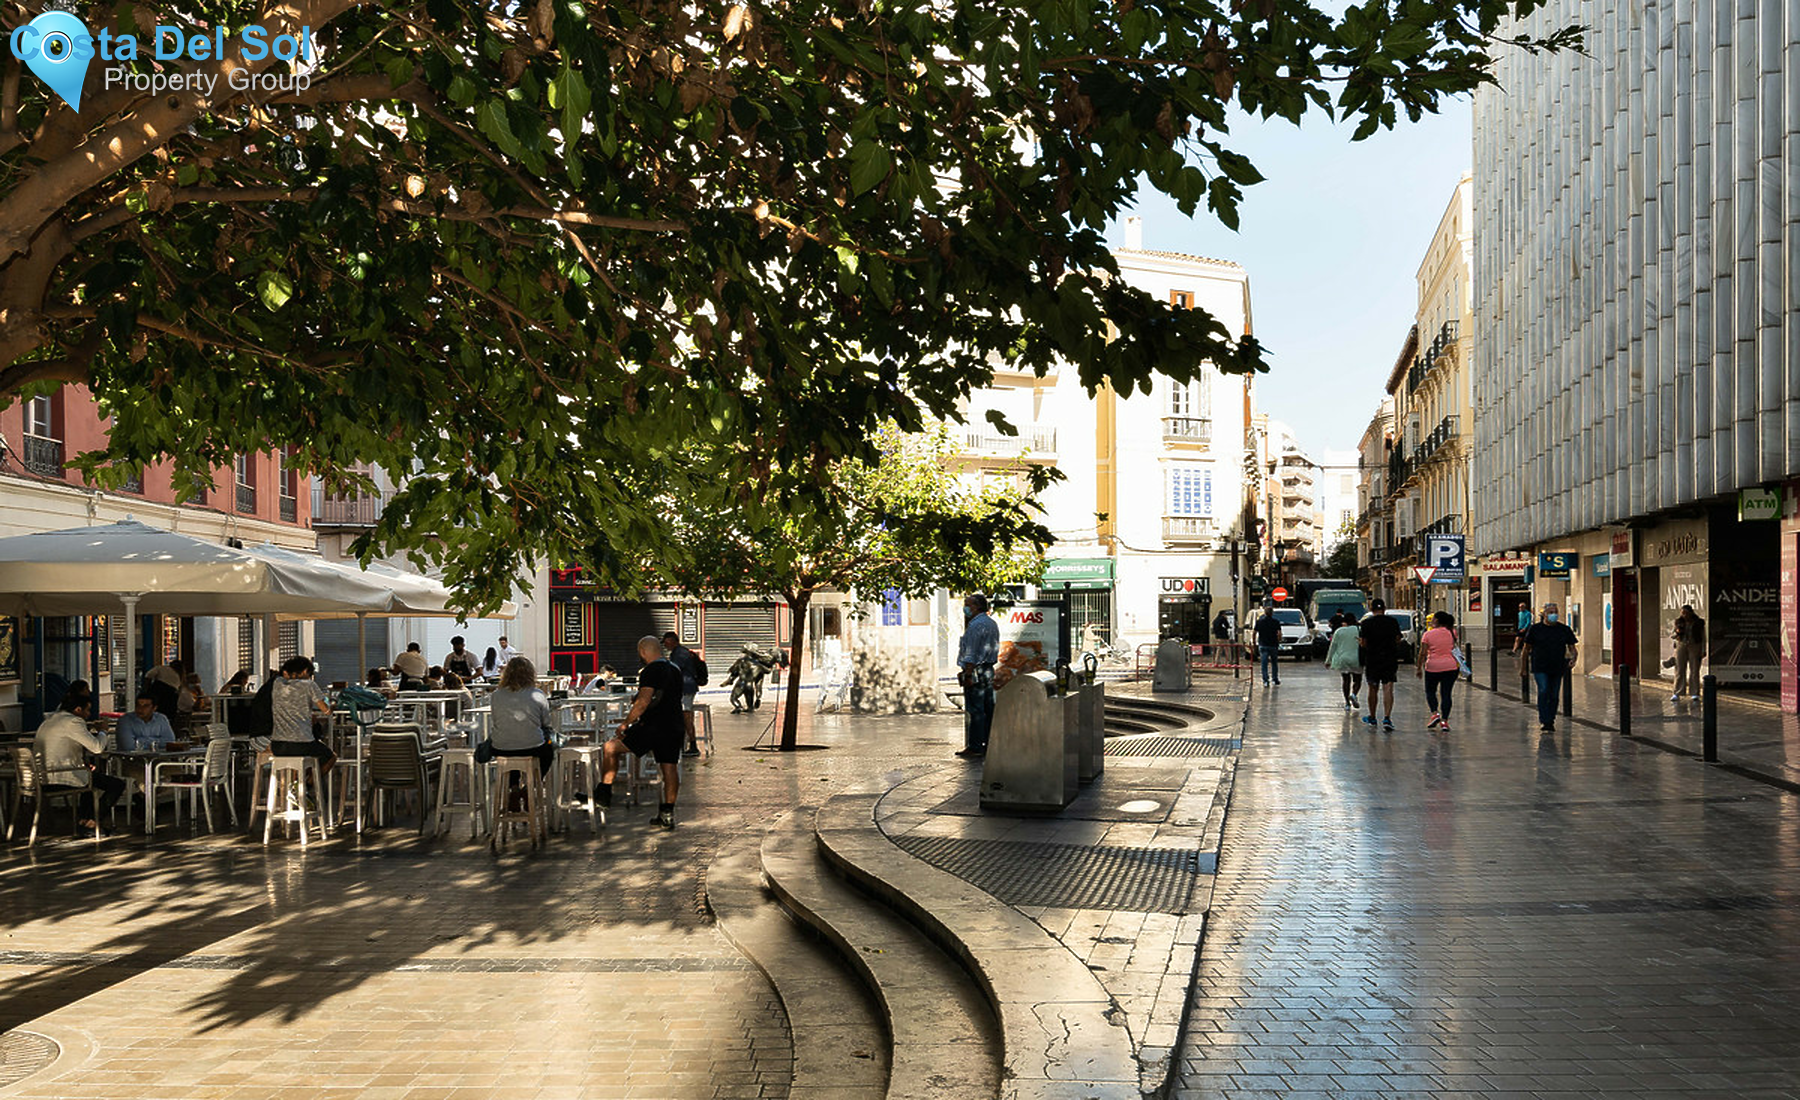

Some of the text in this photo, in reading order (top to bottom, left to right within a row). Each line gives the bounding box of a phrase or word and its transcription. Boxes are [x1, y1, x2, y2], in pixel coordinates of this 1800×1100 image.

[1745, 498, 1776, 510] ATM
[1430, 540, 1460, 567] P
[1553, 556, 1564, 568] S
[1162, 579, 1205, 593] UDON
[1716, 588, 1780, 603] ANDE
